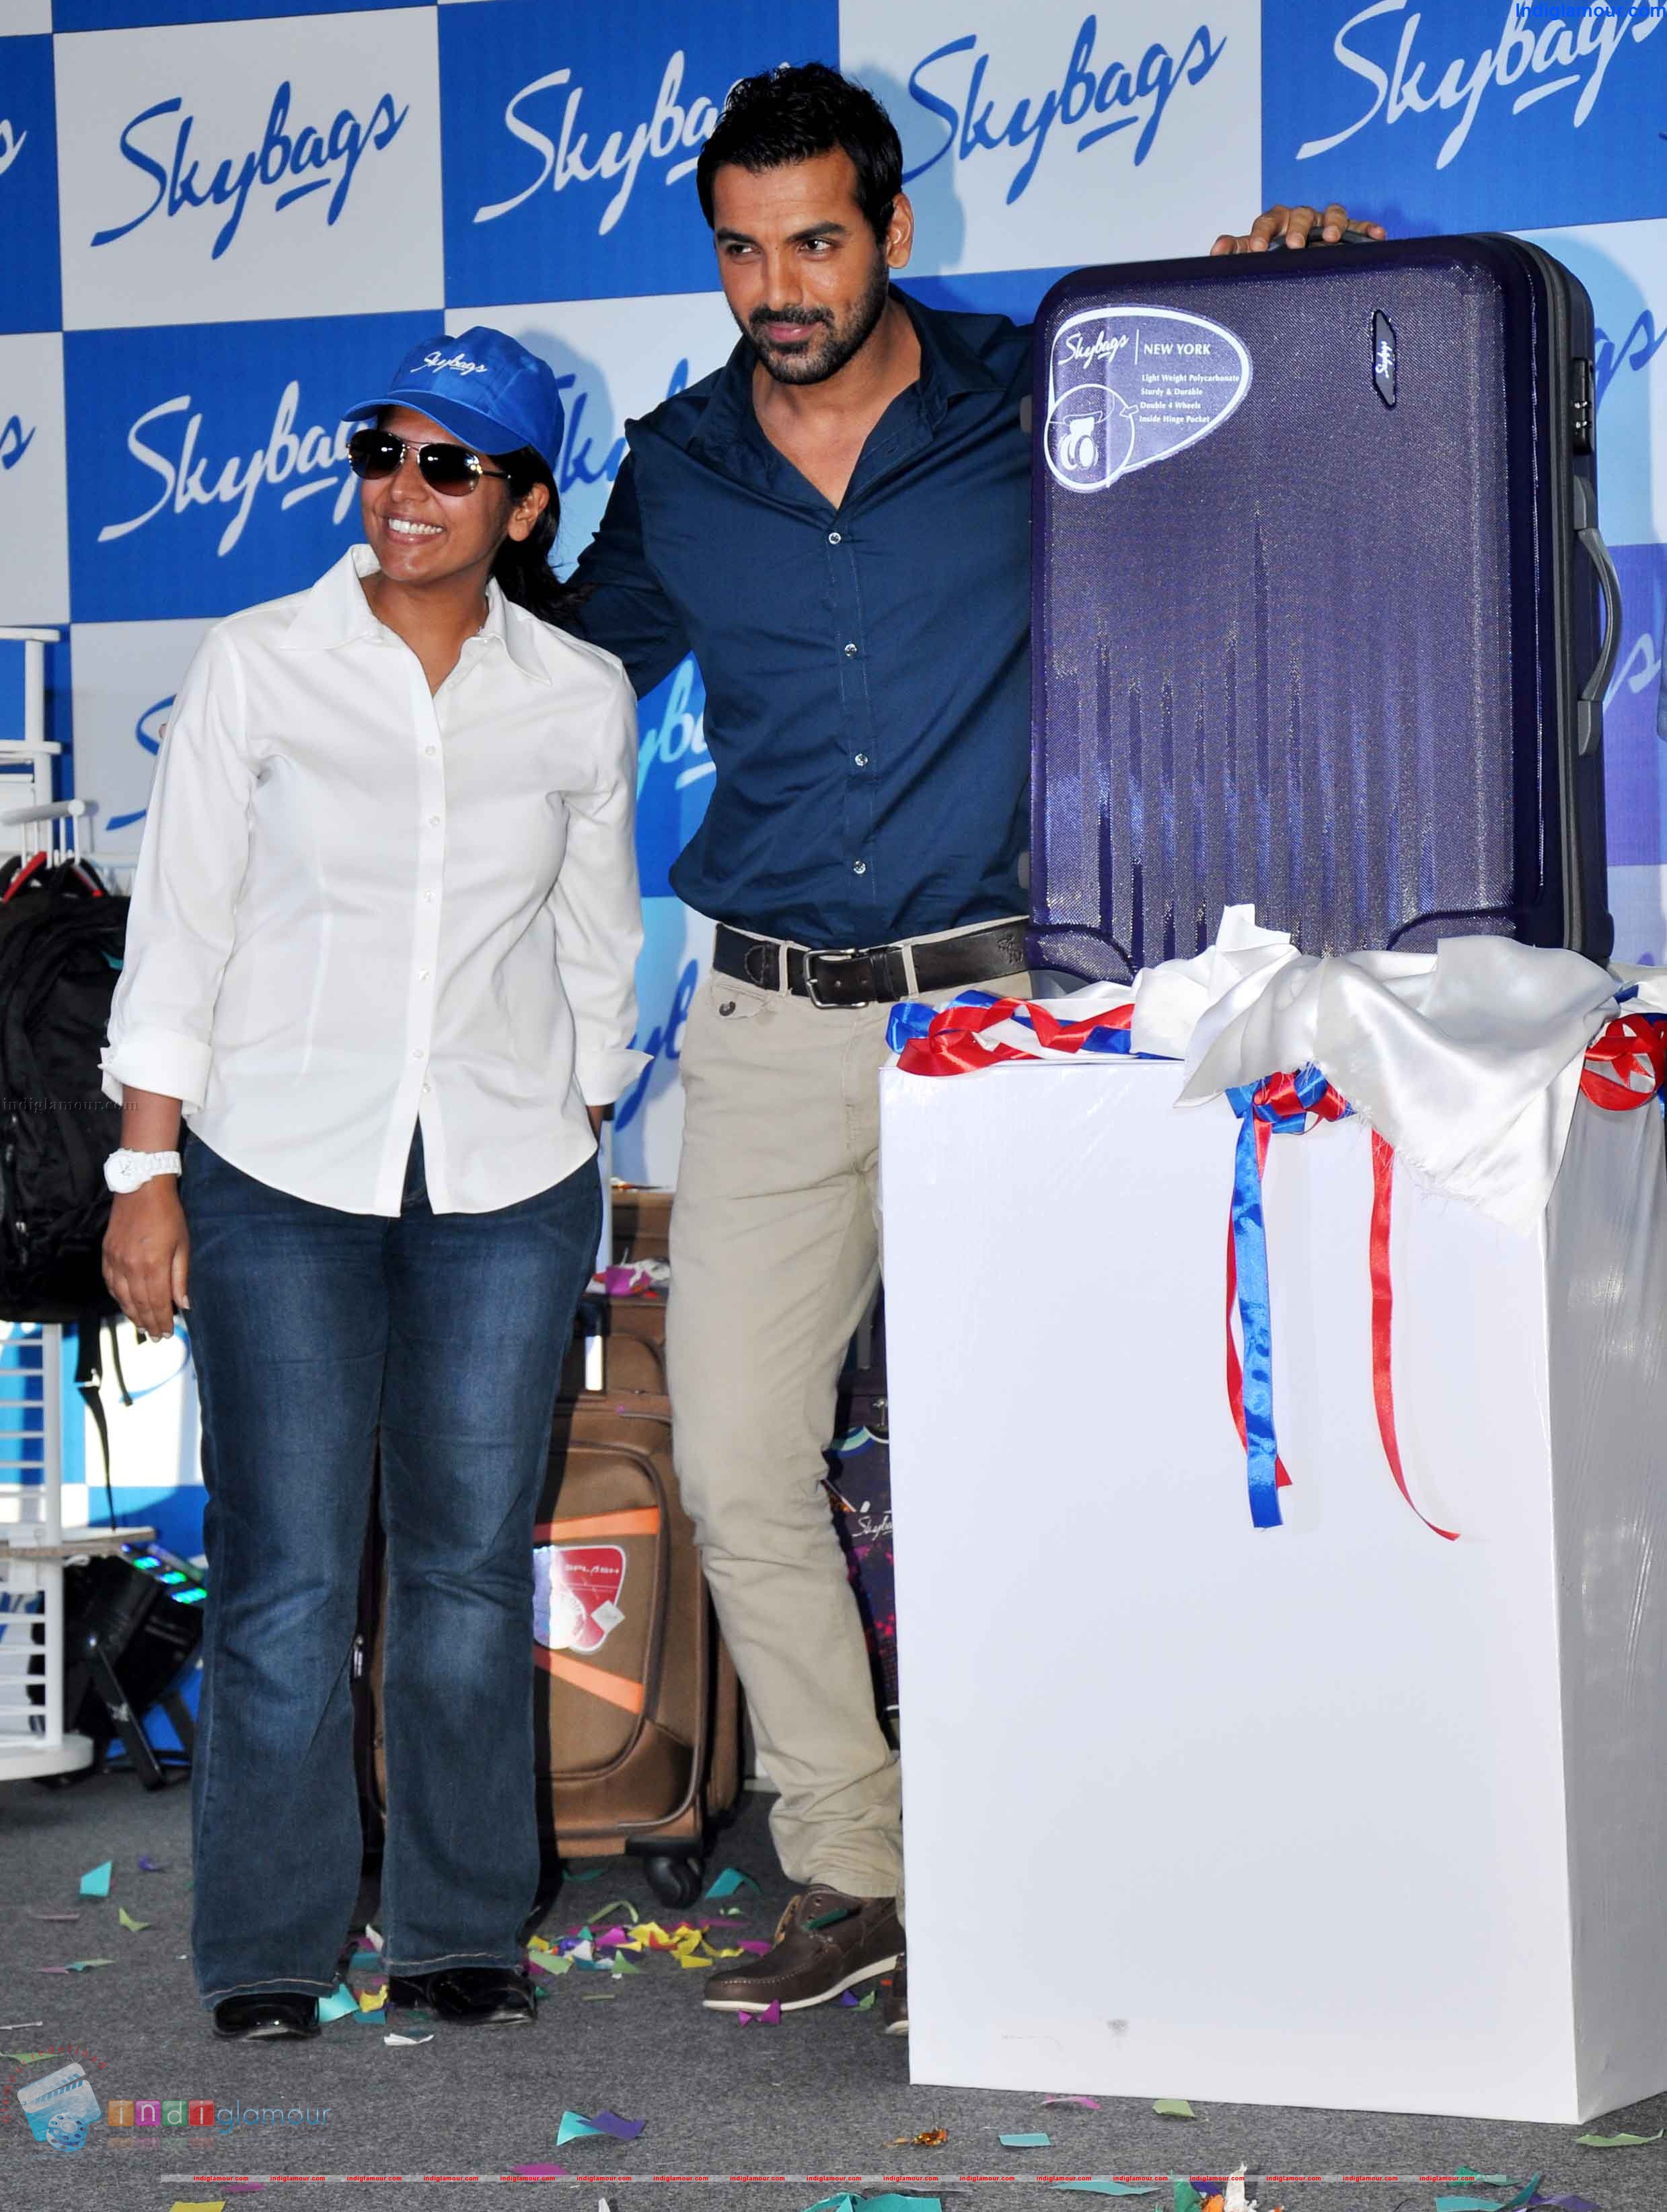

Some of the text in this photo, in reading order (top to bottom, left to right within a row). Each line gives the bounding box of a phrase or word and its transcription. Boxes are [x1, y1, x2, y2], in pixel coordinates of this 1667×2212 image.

[902, 14, 1227, 205] Skybags
[473, 50, 747, 235] Skyba
[90, 81, 409, 260] Skybags
[1057, 330, 1129, 369] Skybags
[1144, 343, 1212, 355] NEW YORK
[1142, 373, 1240, 383] Light Weight Polycarbonate
[1140, 388, 1203, 396] Sturdy & Durable
[1140, 401, 1165, 409] Double
[1175, 401, 1201, 409] Wheels
[1139, 415, 1210, 425] Inside Hinge Pocket
